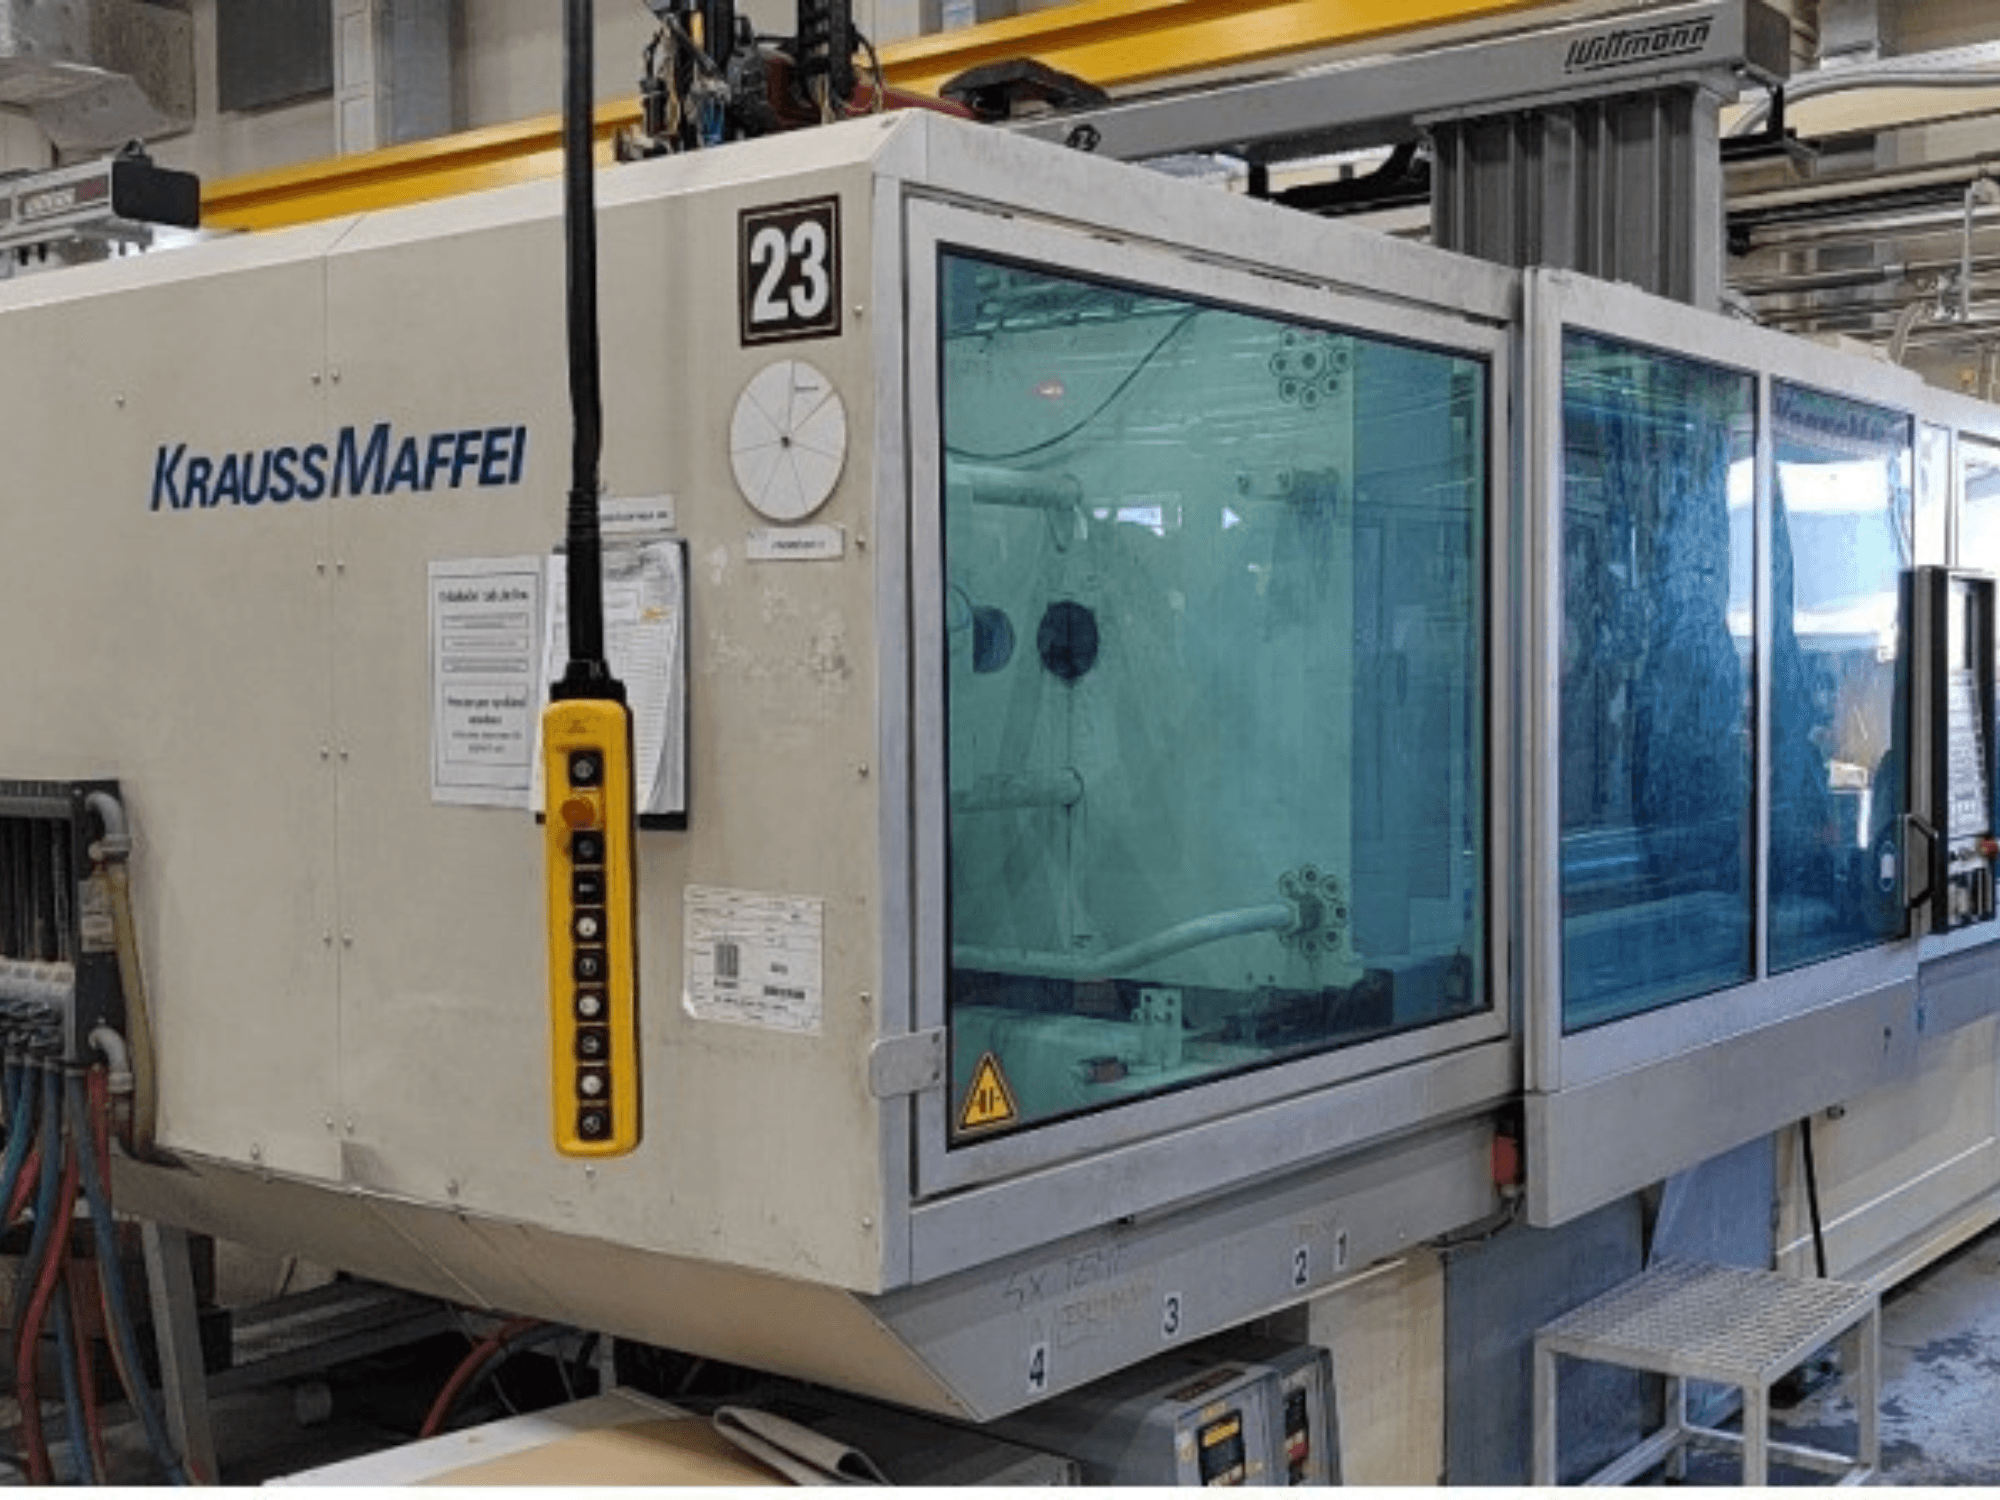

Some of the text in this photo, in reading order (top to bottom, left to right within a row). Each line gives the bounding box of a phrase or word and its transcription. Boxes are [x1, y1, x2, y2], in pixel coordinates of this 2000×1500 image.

[750, 219, 829, 323] 23
[1294, 1249, 1308, 1286] 2
[1338, 1230, 1348, 1267] 1
[1163, 1296, 1181, 1335] 3
[1028, 1347, 1045, 1387] 4
